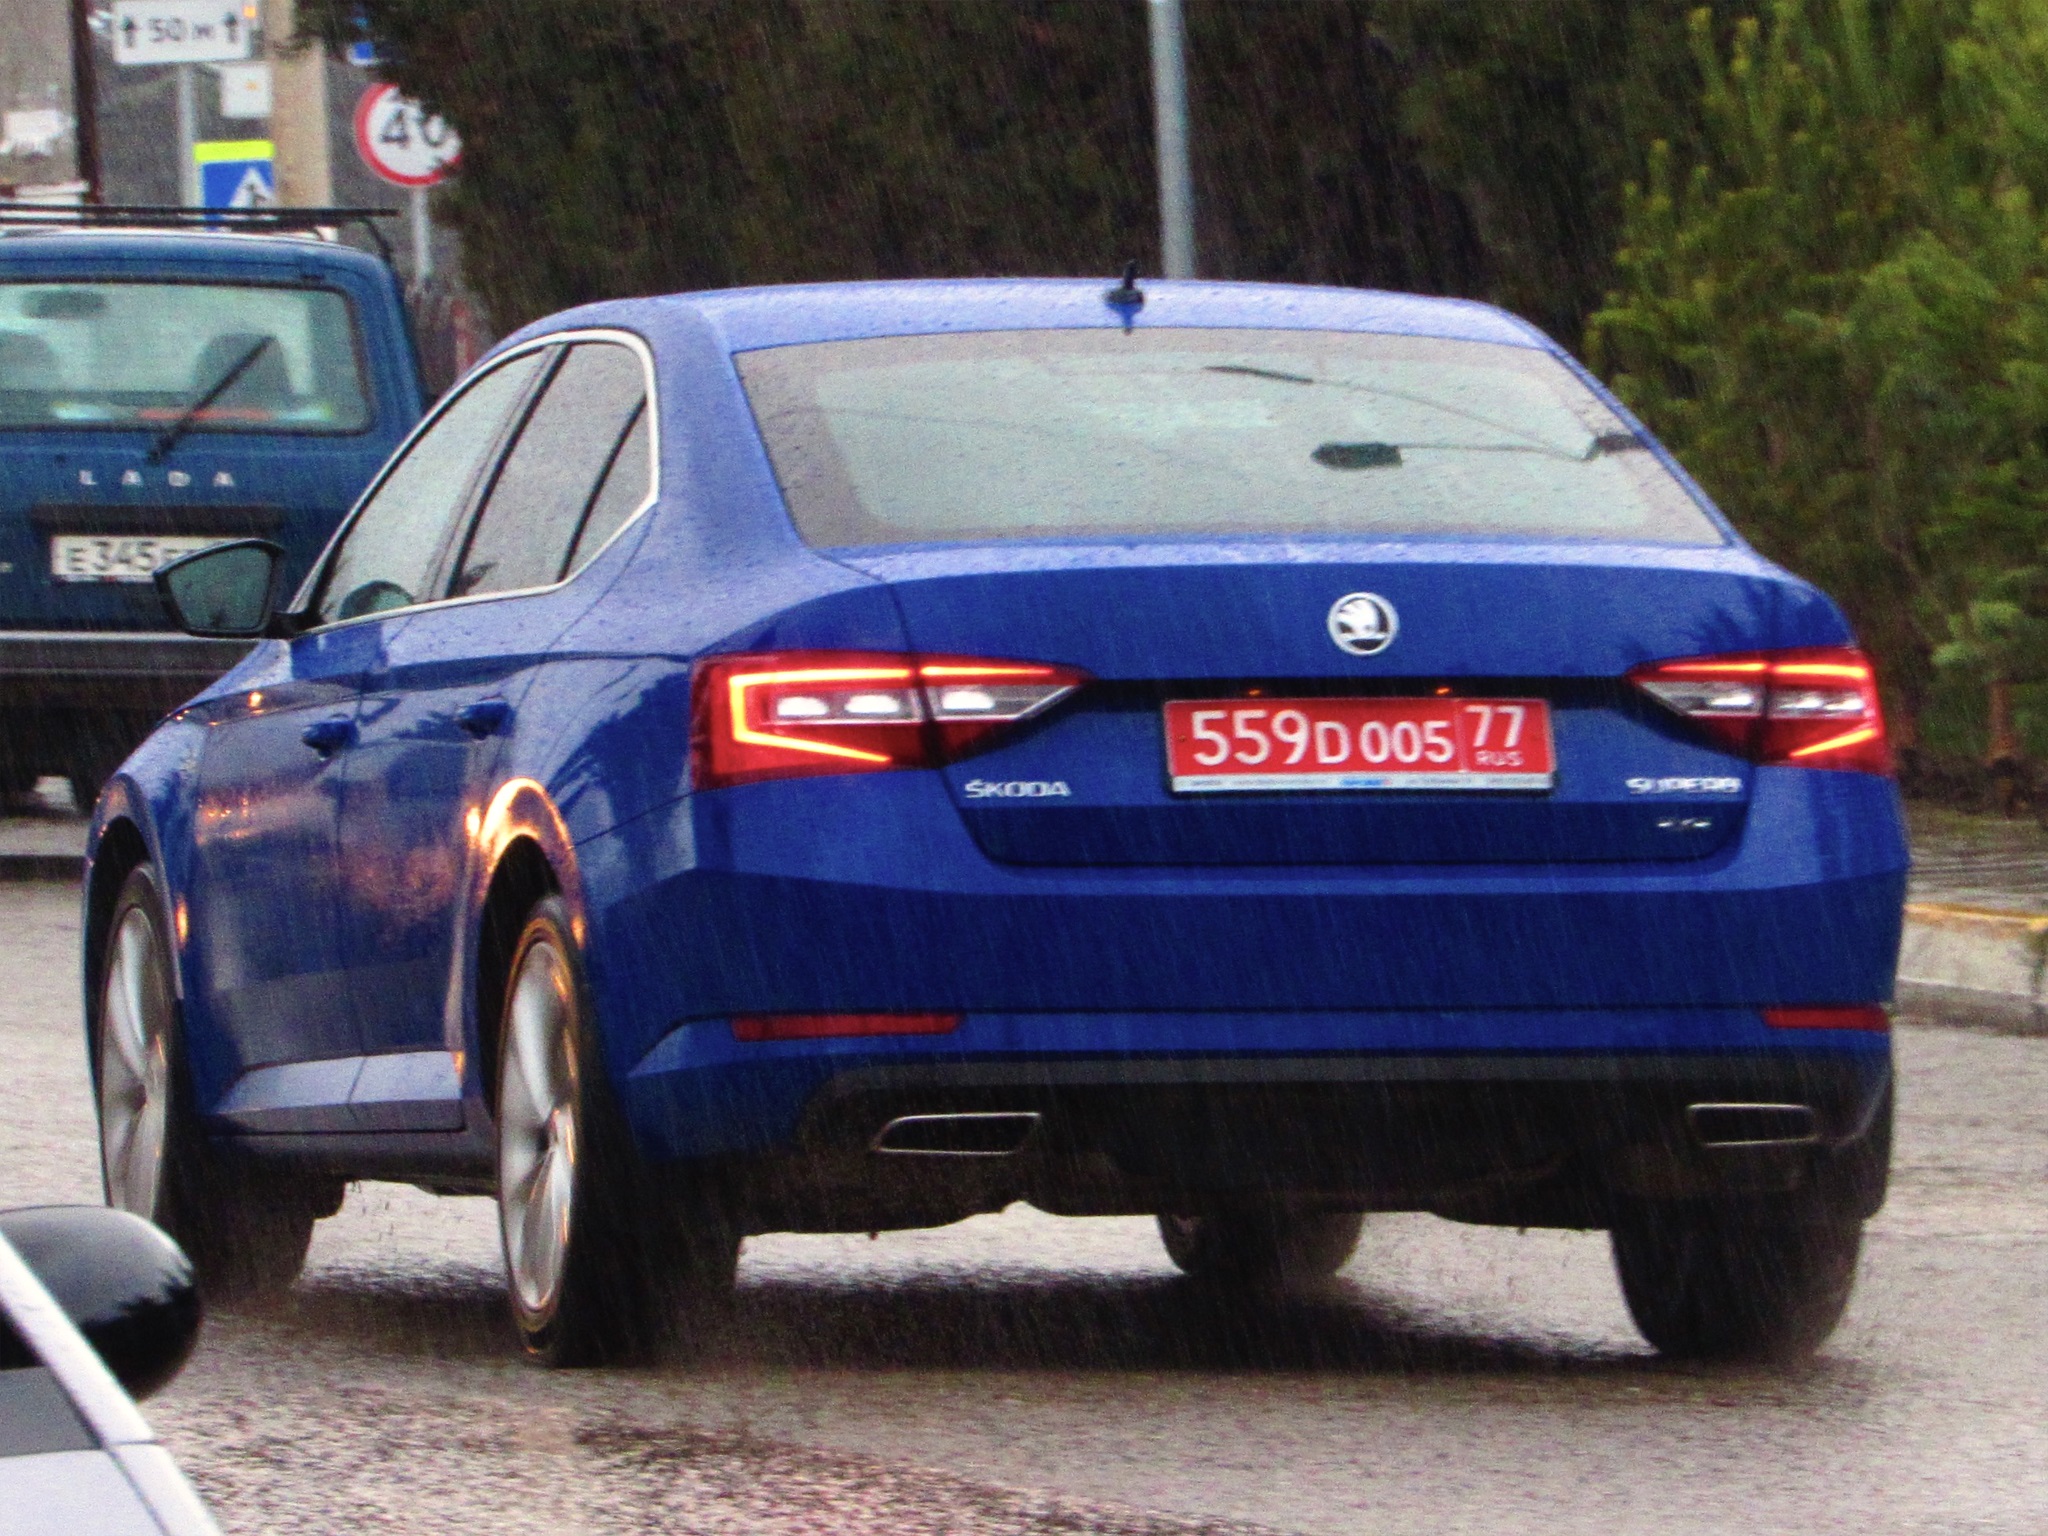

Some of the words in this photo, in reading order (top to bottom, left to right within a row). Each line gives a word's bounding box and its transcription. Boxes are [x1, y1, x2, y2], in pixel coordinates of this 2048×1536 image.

[149, 16, 187, 42] 50
[78, 469, 235, 487] LADA
[1358, 720, 1455, 763] 005
[1464, 705, 1526, 748] 77
[1475, 751, 1525, 767] RUS
